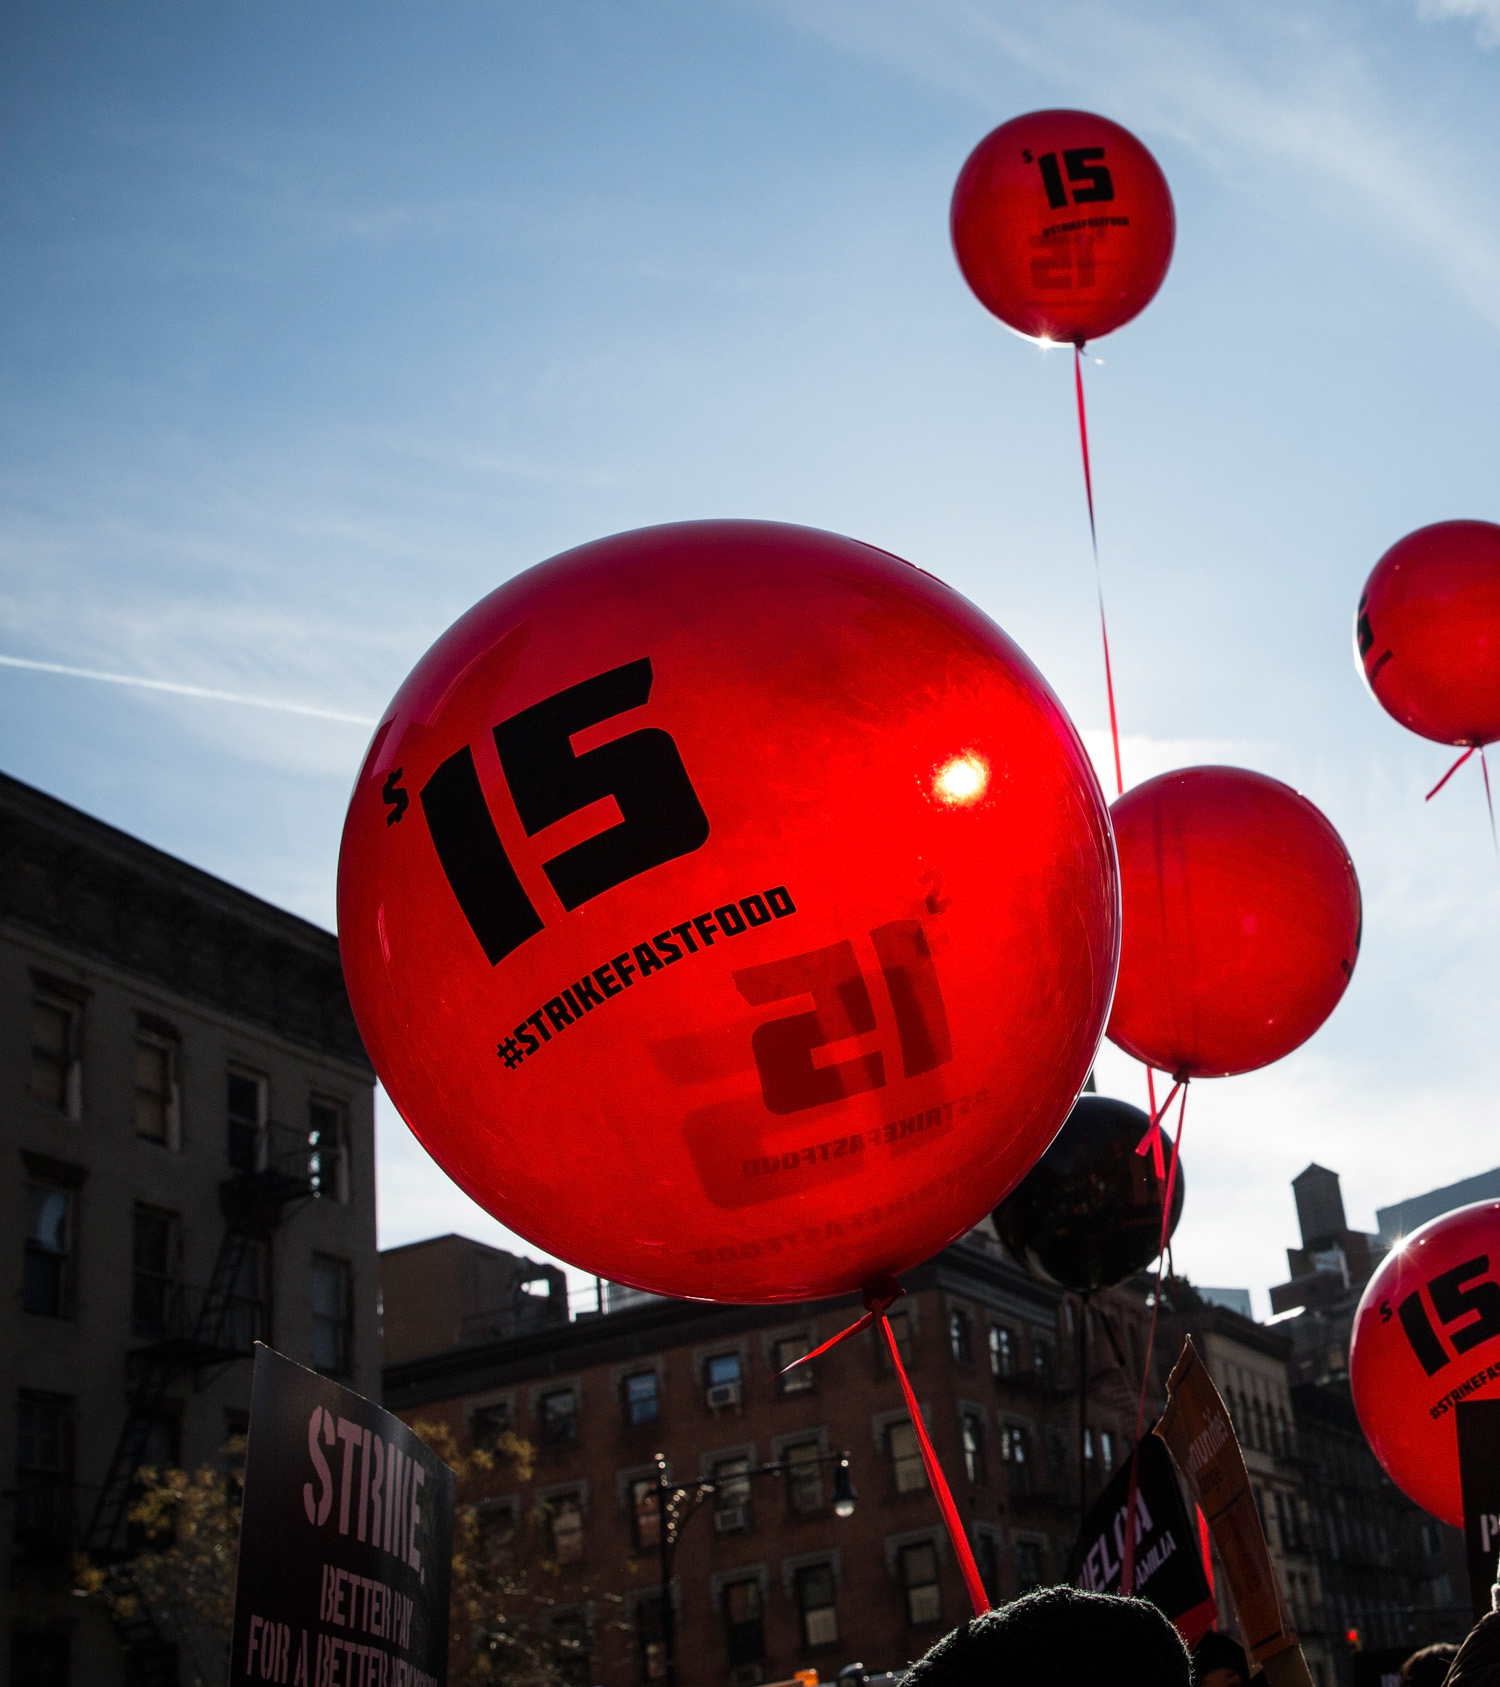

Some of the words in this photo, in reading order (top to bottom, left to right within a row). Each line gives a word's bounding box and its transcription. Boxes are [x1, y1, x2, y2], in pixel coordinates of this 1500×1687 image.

[1021, 147, 1115, 210] $15
[381, 656, 711, 967] $15
[496, 886, 797, 1070] #STRIKEFASTFOOD
[319, 1563, 392, 1641] BETTER
[246, 1612, 291, 1685] FOR
[293, 1627, 309, 1687] A
